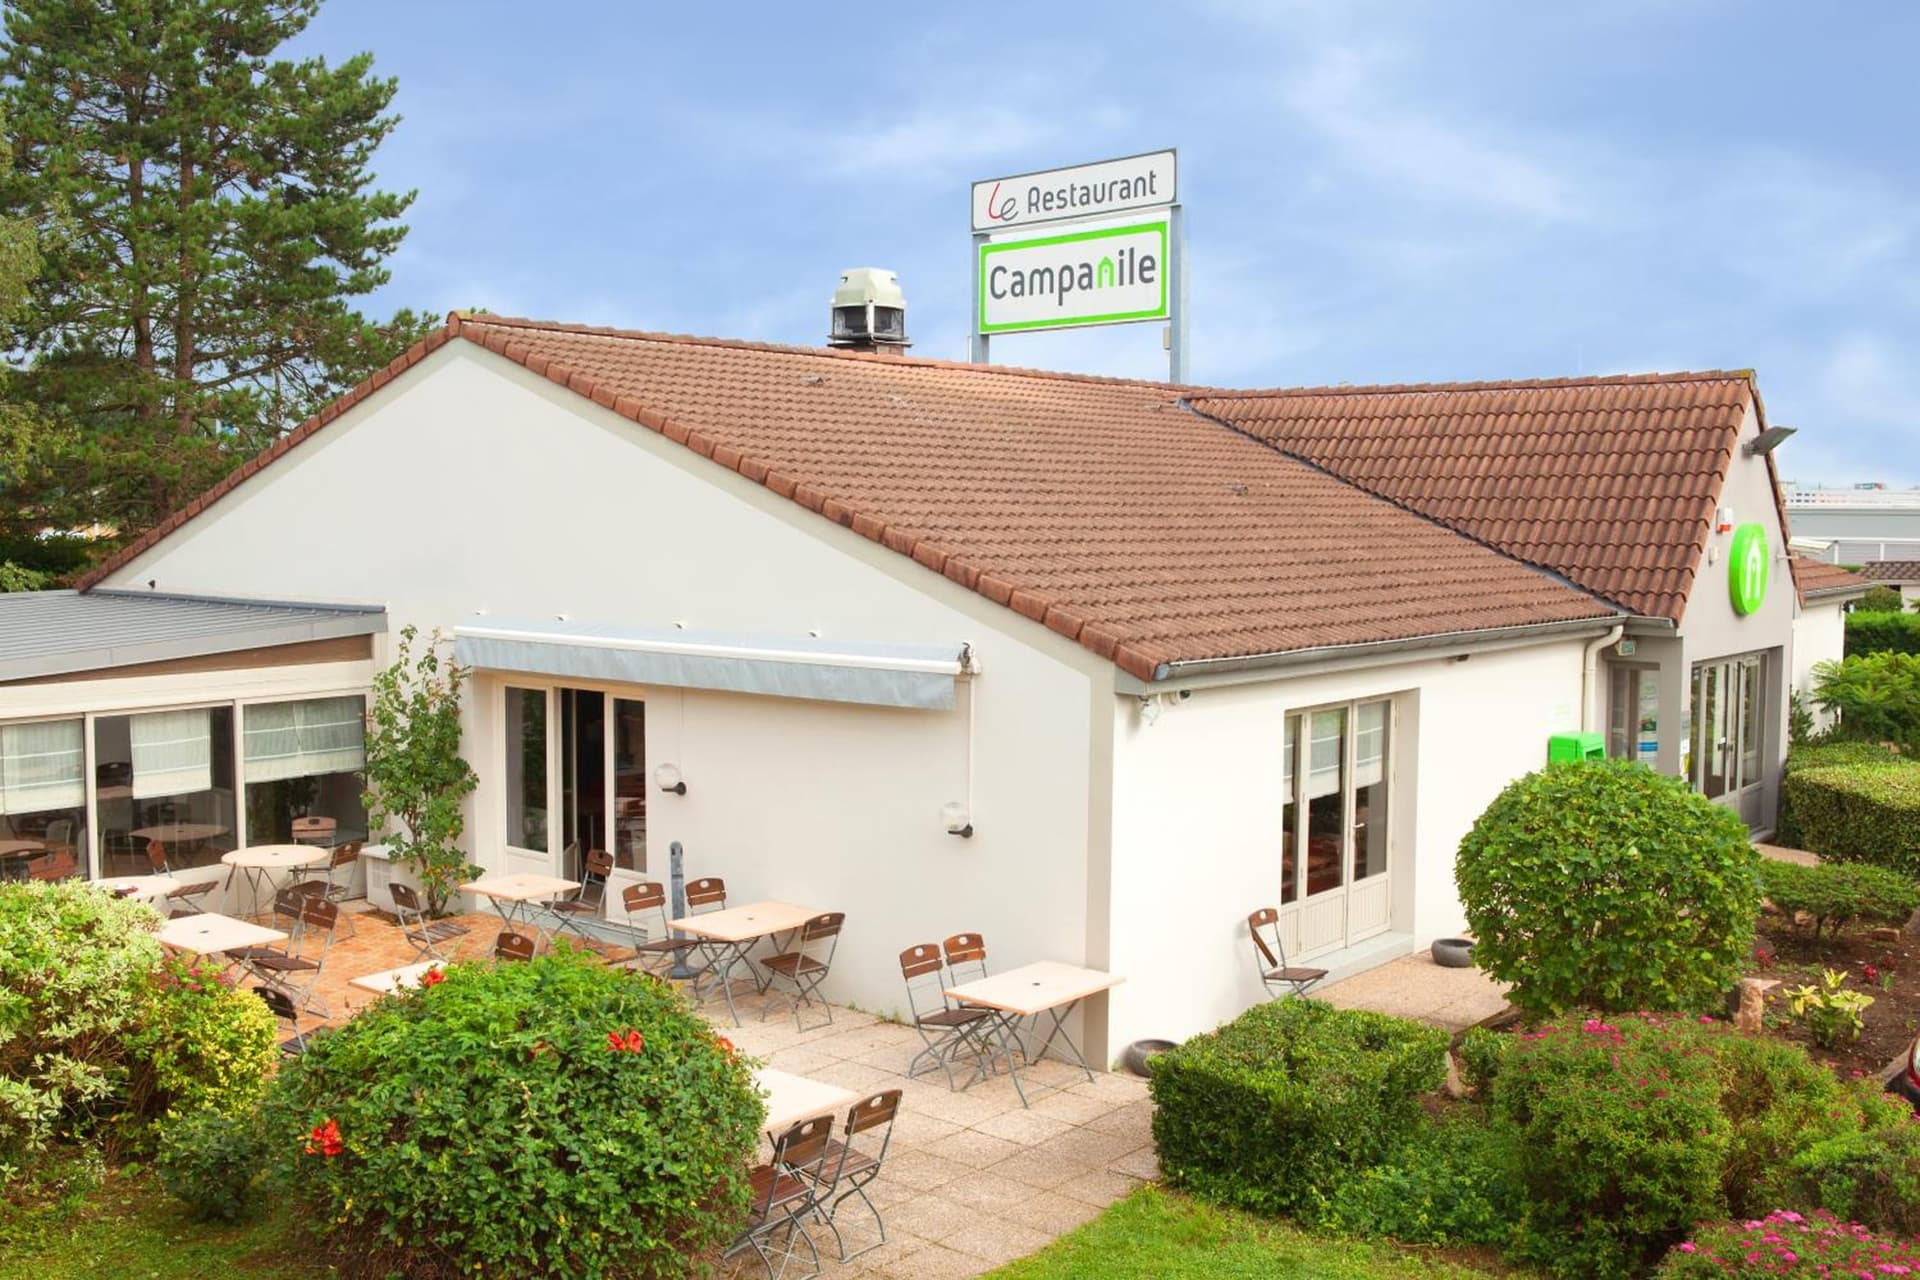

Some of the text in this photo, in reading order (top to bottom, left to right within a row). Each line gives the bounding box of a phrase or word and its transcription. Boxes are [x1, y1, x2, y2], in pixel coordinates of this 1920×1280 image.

[988, 170, 1156, 221] Le Restaurant
[990, 247, 1156, 306] Campanile
